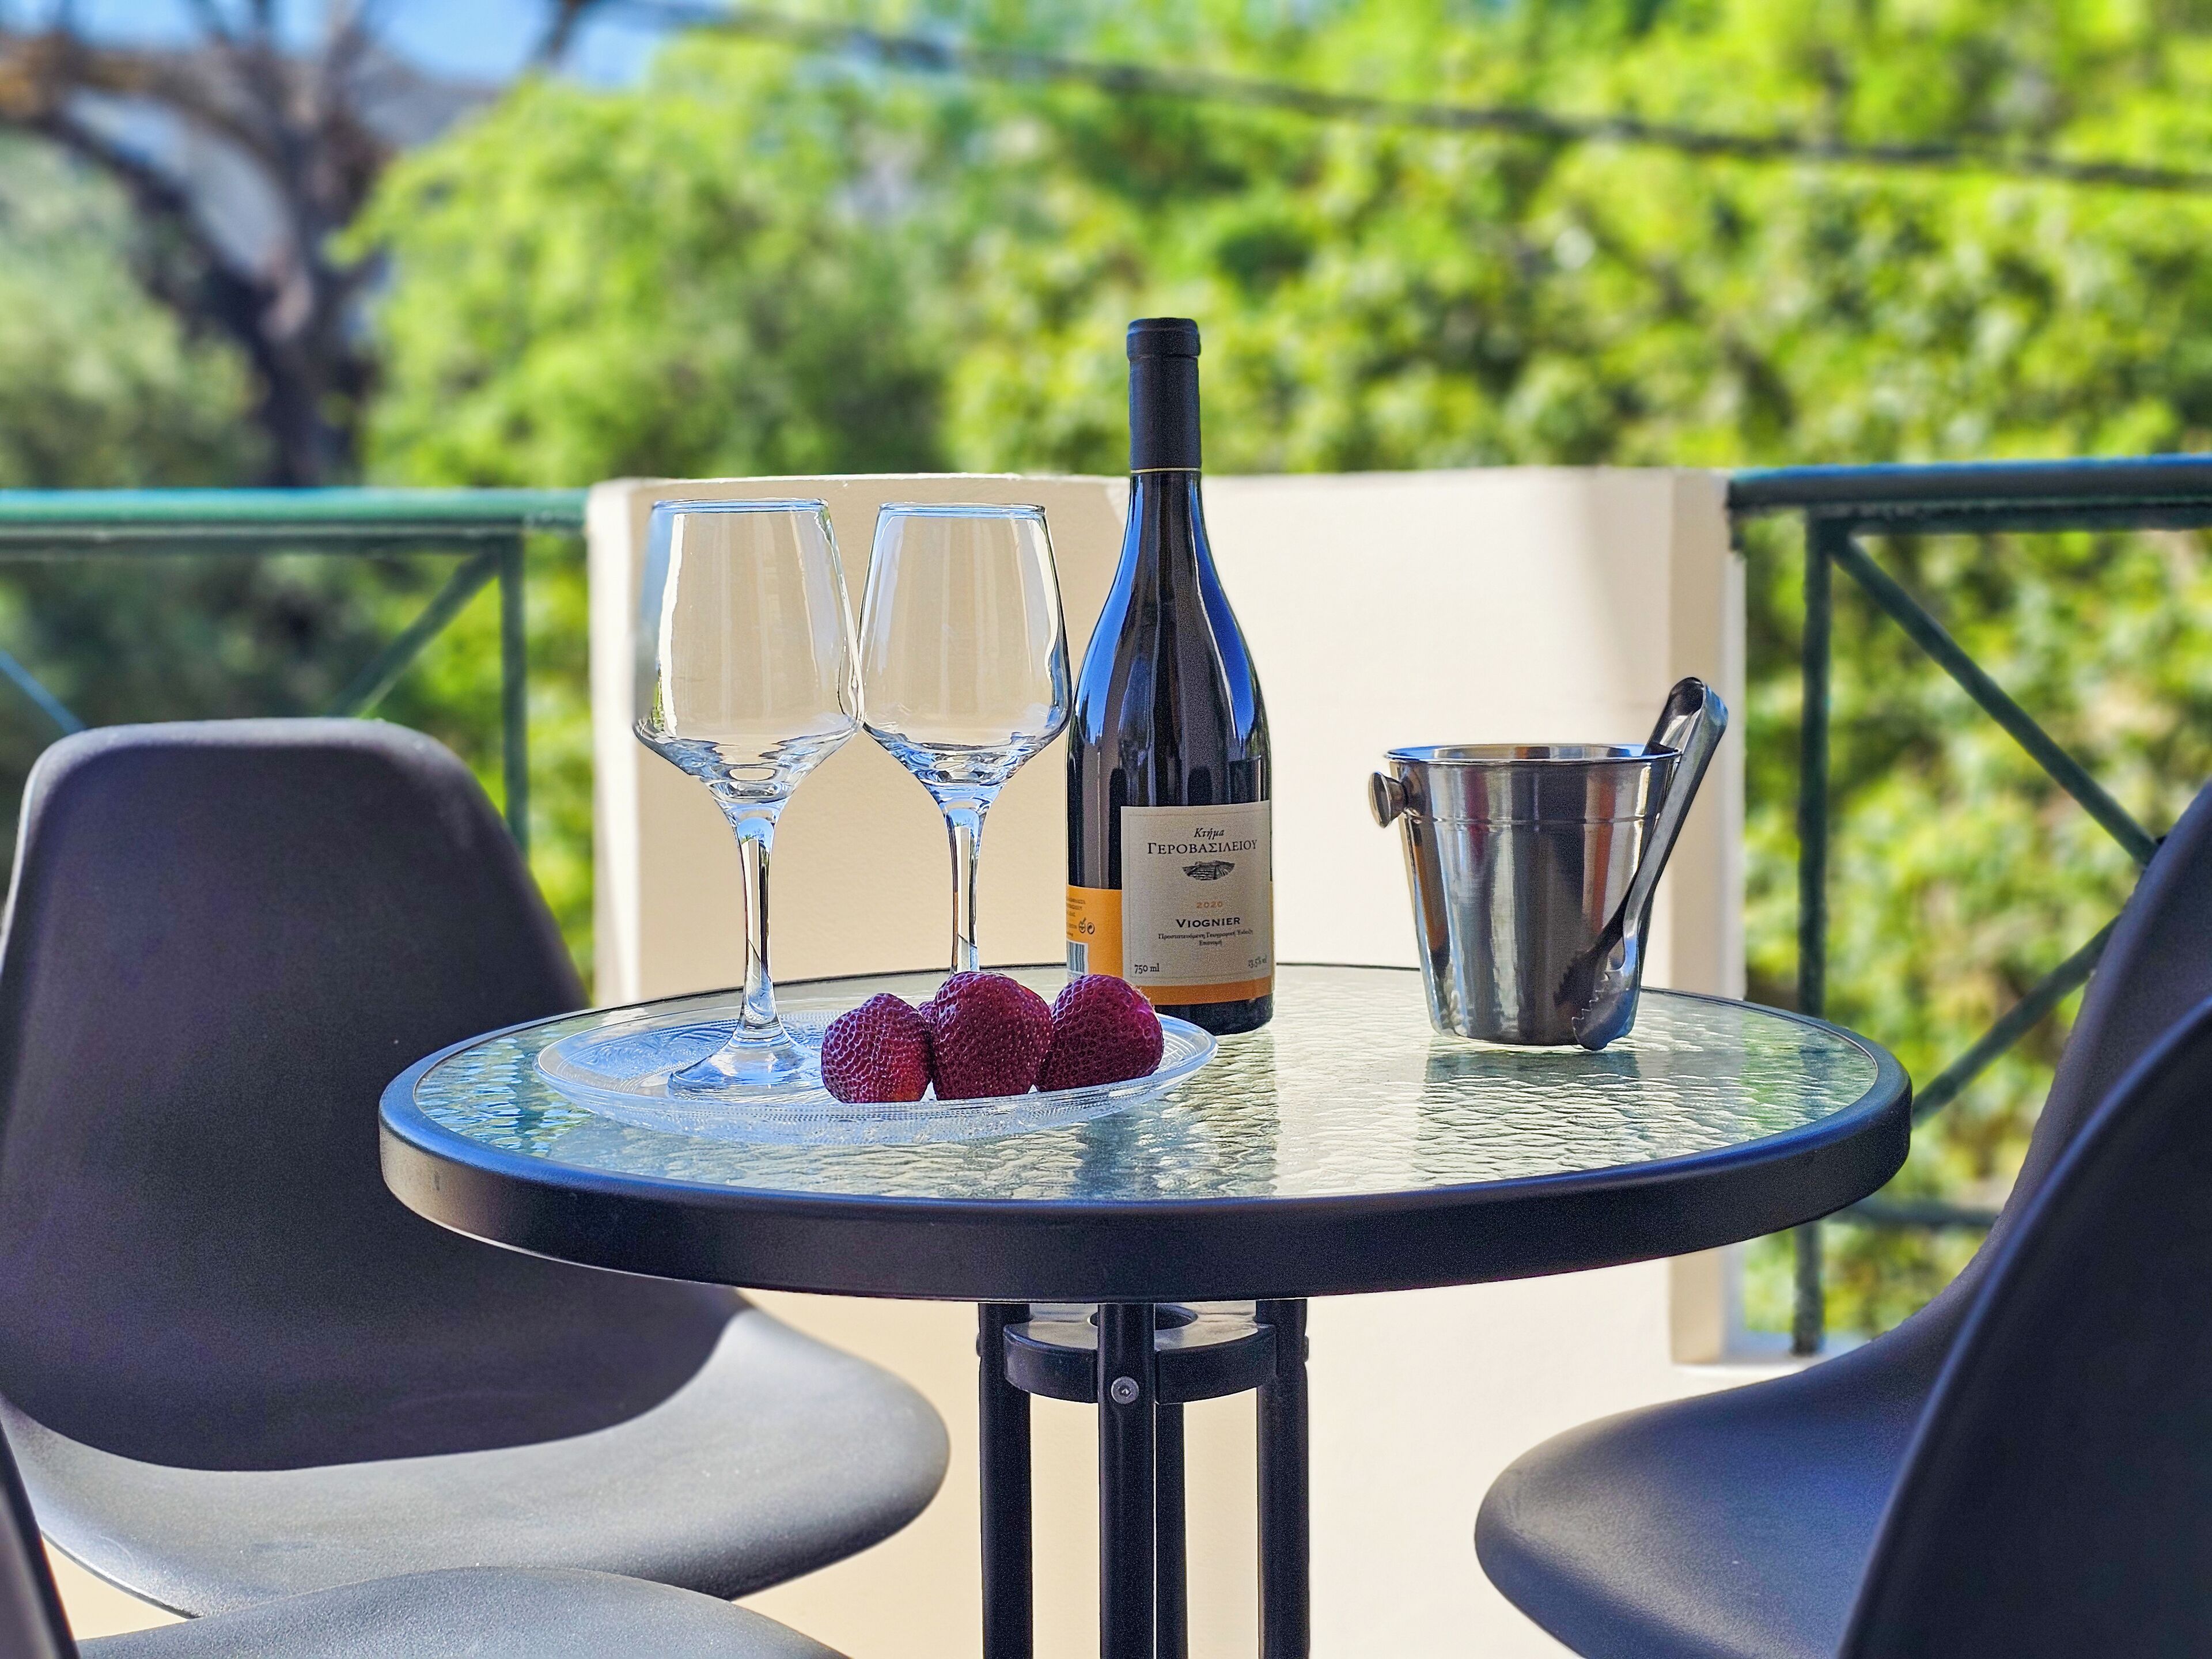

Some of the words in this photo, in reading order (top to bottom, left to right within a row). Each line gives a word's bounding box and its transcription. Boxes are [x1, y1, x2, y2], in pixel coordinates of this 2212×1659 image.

[1194, 828, 1225, 840] Κτήμα
[1147, 840, 1257, 854] ΓΕΡΟΒΑΣΙΛΕΙΟΥ
[1176, 917, 1240, 927] VIOGNIER
[1135, 964, 1148, 974] 750
[1149, 963, 1160, 972] ml
